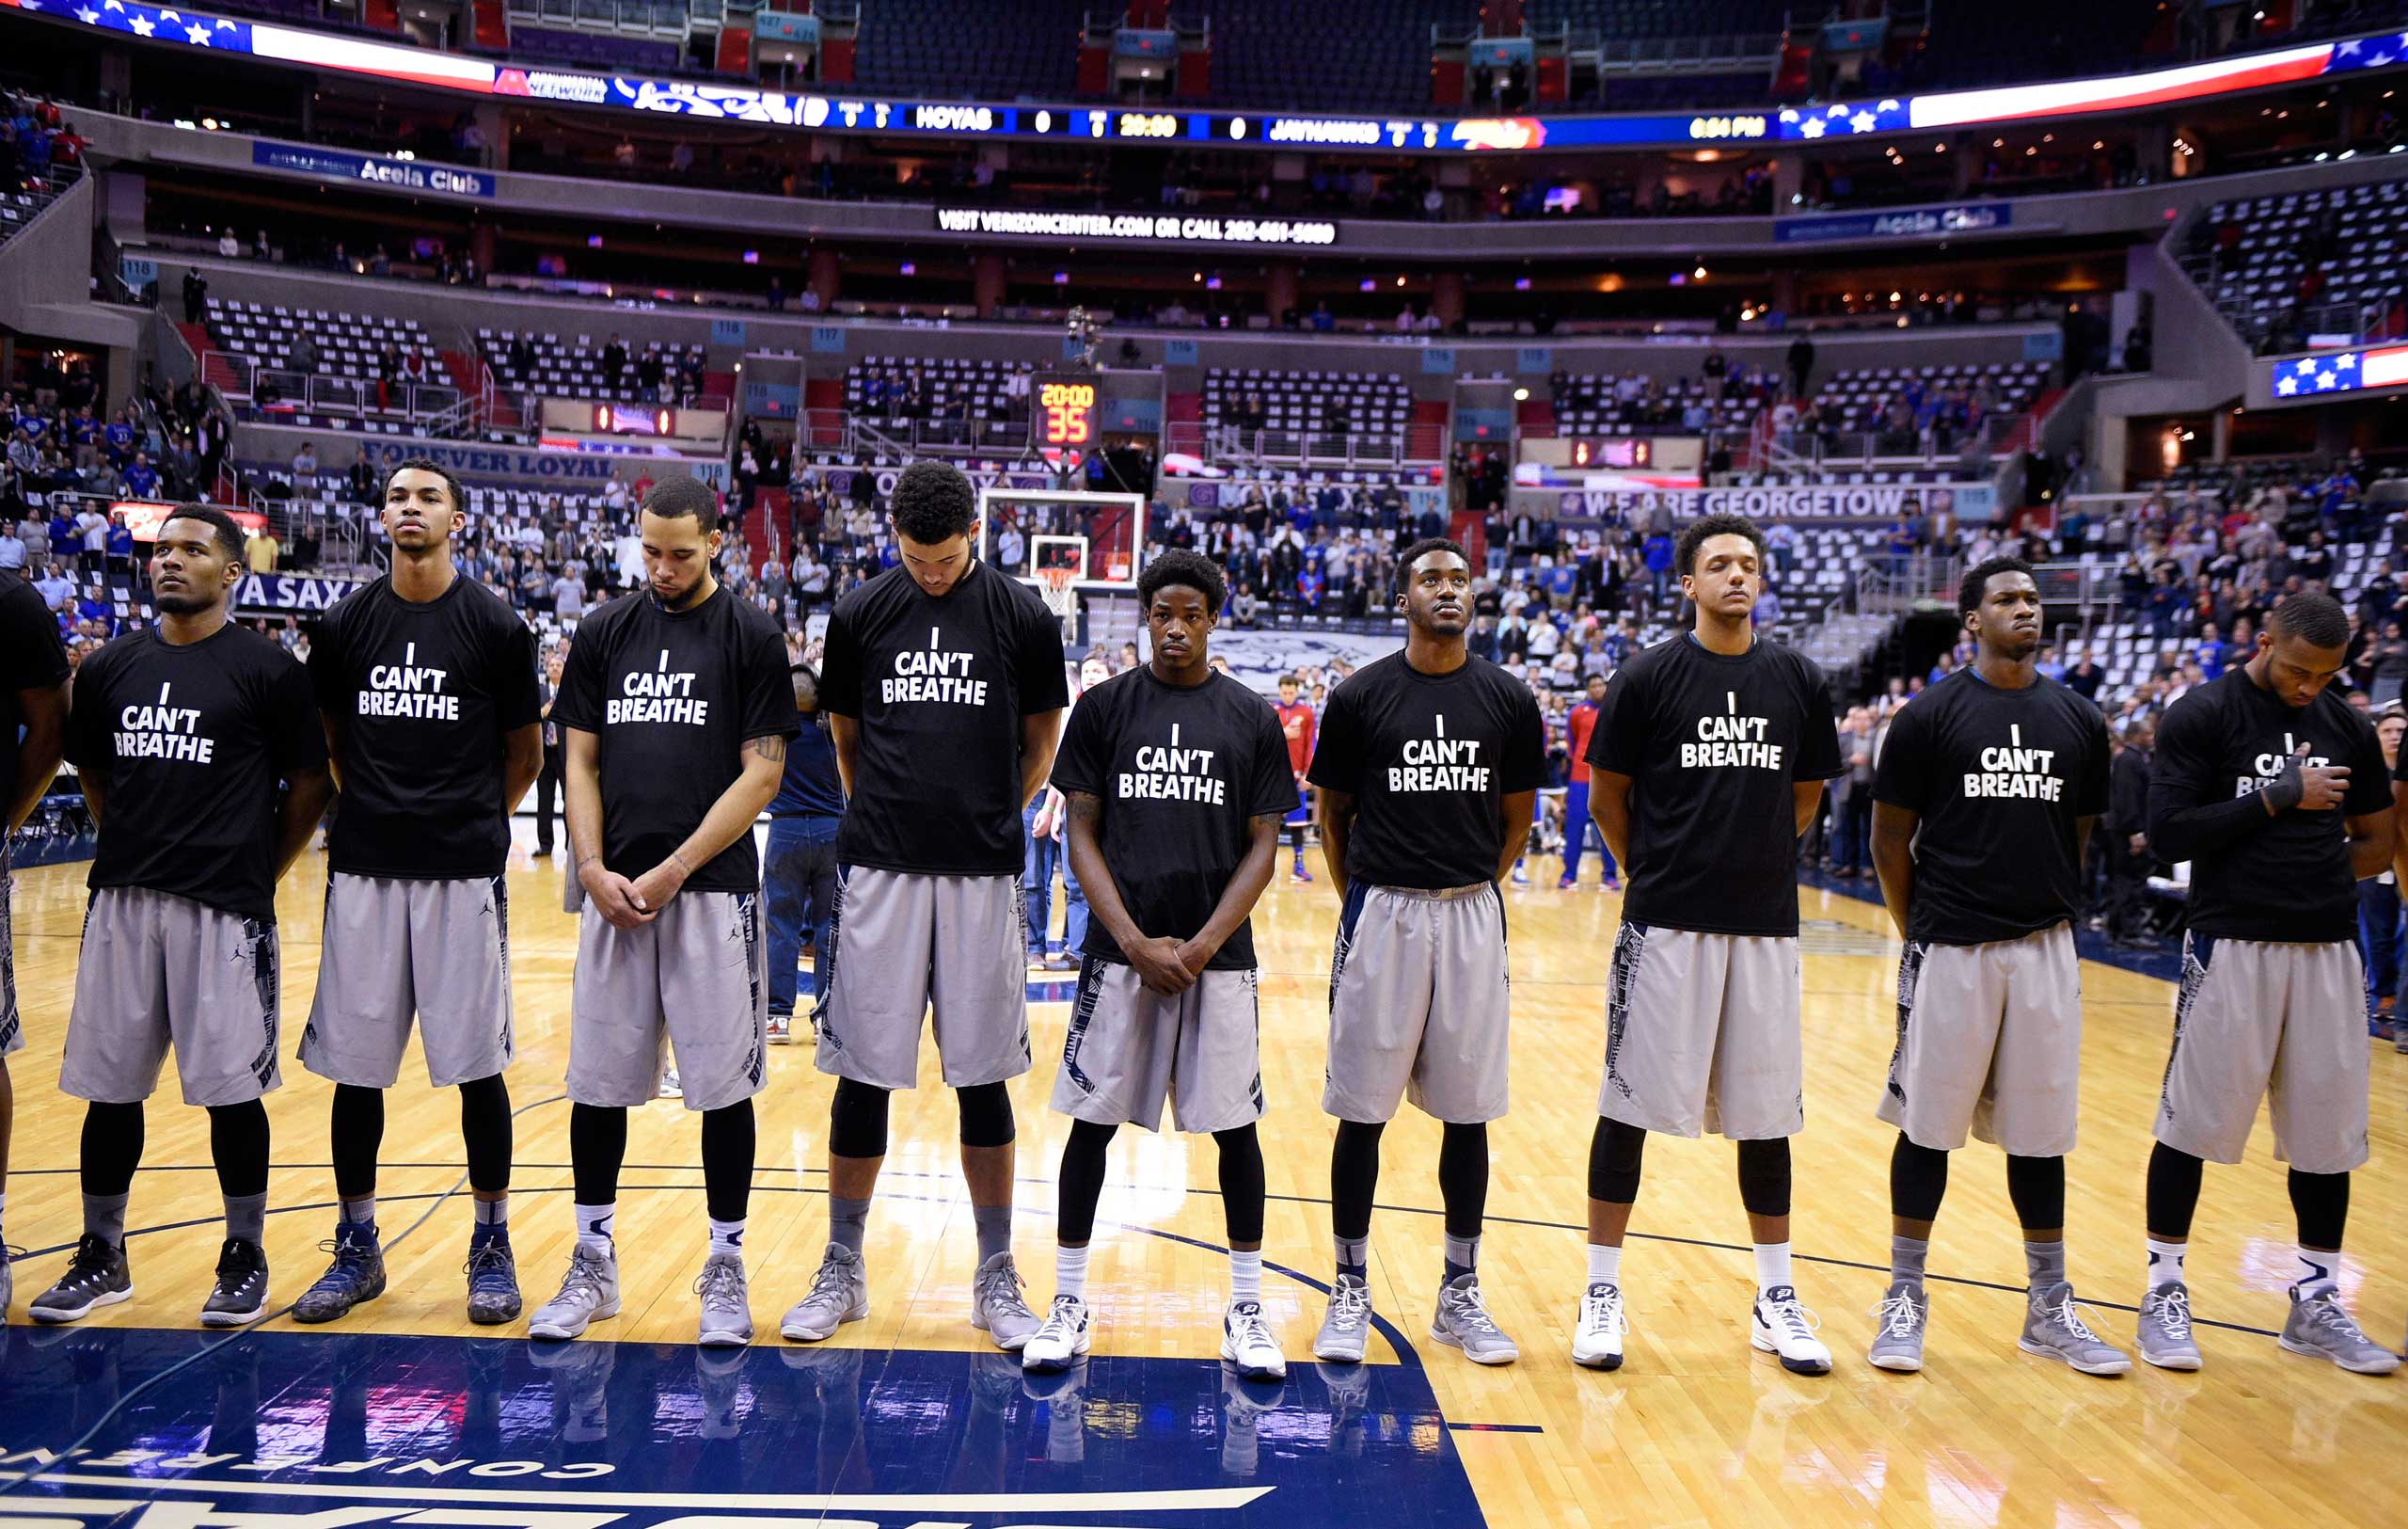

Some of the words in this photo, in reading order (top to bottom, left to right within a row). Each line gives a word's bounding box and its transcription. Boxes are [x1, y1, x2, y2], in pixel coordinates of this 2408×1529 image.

[916, 105, 992, 131] HOYAS
[1120, 113, 1177, 137] 20:00
[1270, 119, 1380, 144] JAYHAWKS
[430, 169, 481, 195] Club
[939, 209, 980, 231] VISIT
[981, 211, 1154, 237] VERIZONCENTER.COM
[1155, 216, 1180, 238] OR
[1181, 217, 1223, 240] CALL
[1041, 383, 1095, 407] 20:00
[1046, 406, 1089, 444] 35
[518, 455, 612, 479] LOYAL
[277, 576, 363, 611] SAX
[931, 627, 939, 650] I
[406, 642, 415, 665] I
[658, 649, 669, 672] I
[895, 651, 974, 677] CAN'T
[371, 665, 447, 693] CAN'T
[623, 672, 695, 698] CAN'T
[881, 677, 988, 706] BREATHE
[159, 682, 170, 705] I
[358, 691, 459, 721] BREATHE
[1727, 691, 1735, 715] I
[122, 706, 201, 735] CAN'T
[607, 697, 708, 725] BREATHE
[1171, 724, 1179, 746] I
[1436, 714, 1444, 738] I
[1697, 716, 1768, 742] CAN'T
[2011, 724, 2020, 747] I
[114, 733, 214, 764] BREATHE
[1402, 740, 1480, 765] CAN'T
[1681, 742, 1782, 771] BREATHE
[2284, 733, 2294, 755] I
[1135, 746, 1214, 775] CAN'T
[1980, 747, 2054, 773] CAN'T
[1118, 772, 1226, 805] BREATHE
[1388, 766, 1491, 792] BREATHE
[1964, 773, 2064, 802] BREATHE
[0, 1445, 616, 1480] CONFEREN
